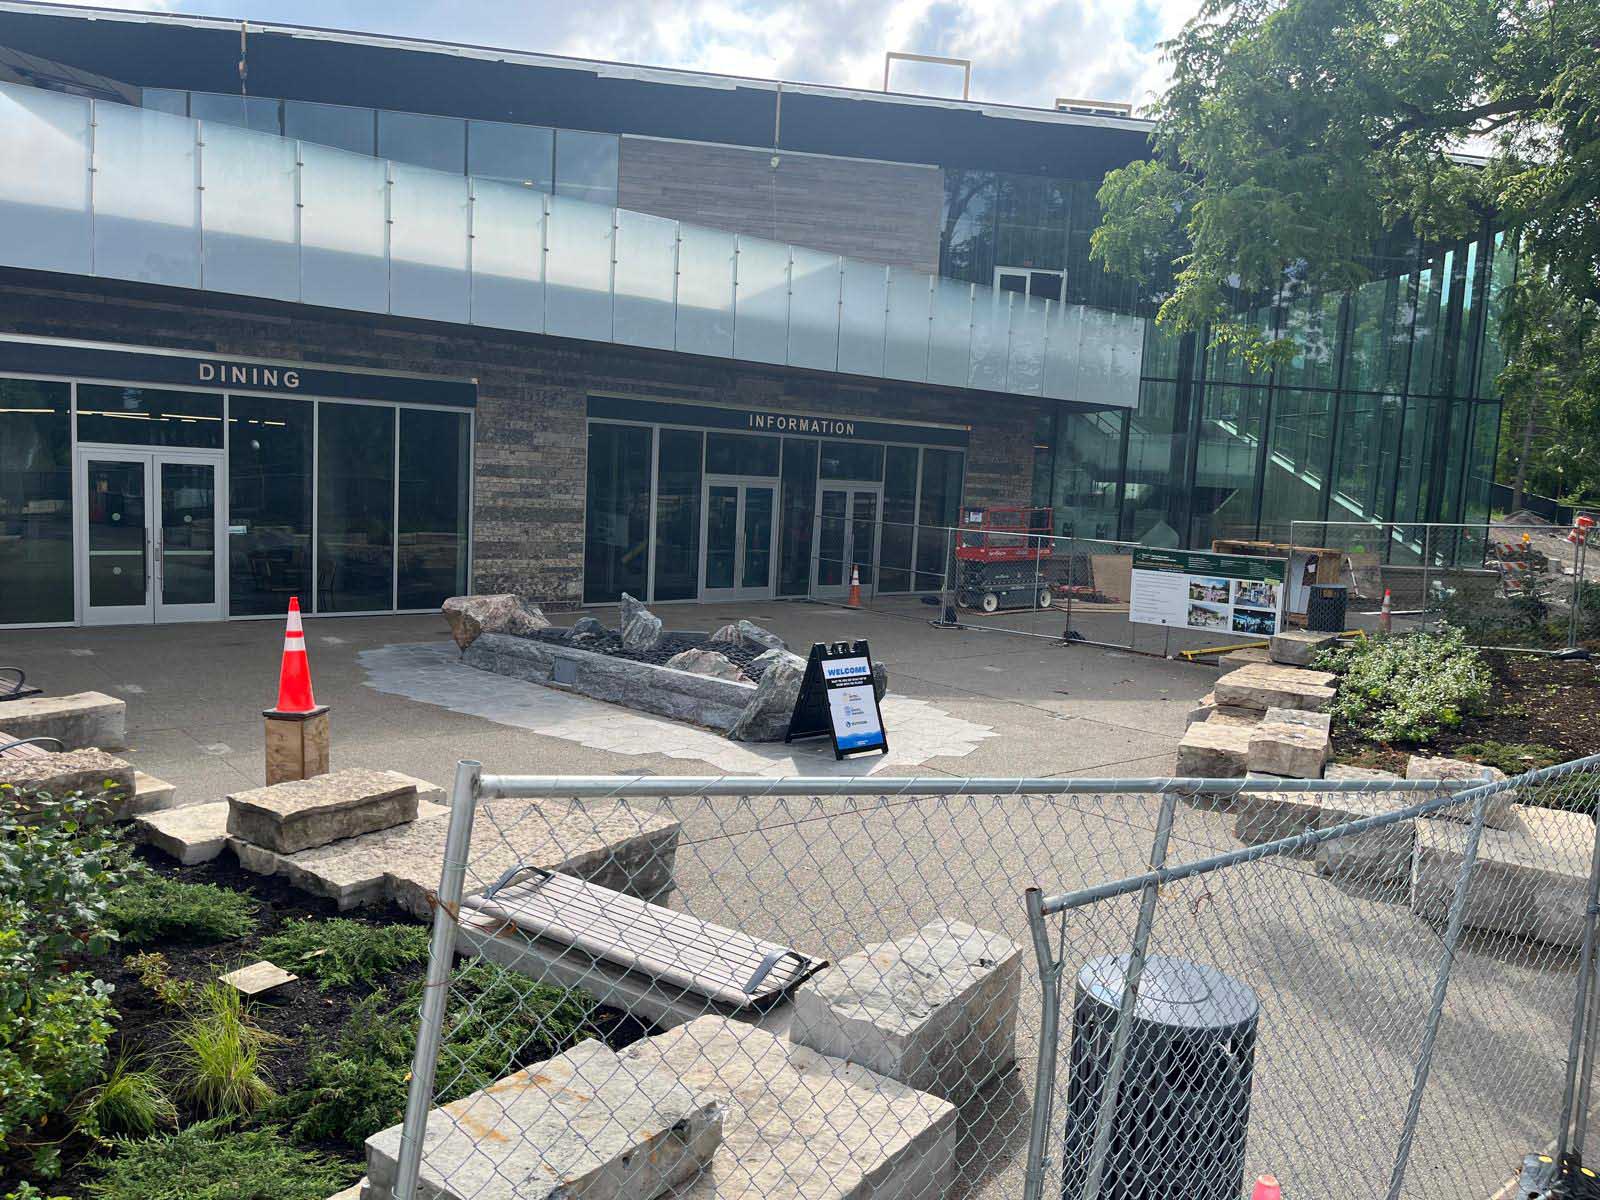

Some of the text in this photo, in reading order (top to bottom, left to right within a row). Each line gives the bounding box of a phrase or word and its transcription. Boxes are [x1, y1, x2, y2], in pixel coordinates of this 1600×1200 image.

[199, 363, 300, 388] DINING
[749, 414, 854, 435] INFORMATION
[827, 665, 867, 676] WELCOME
